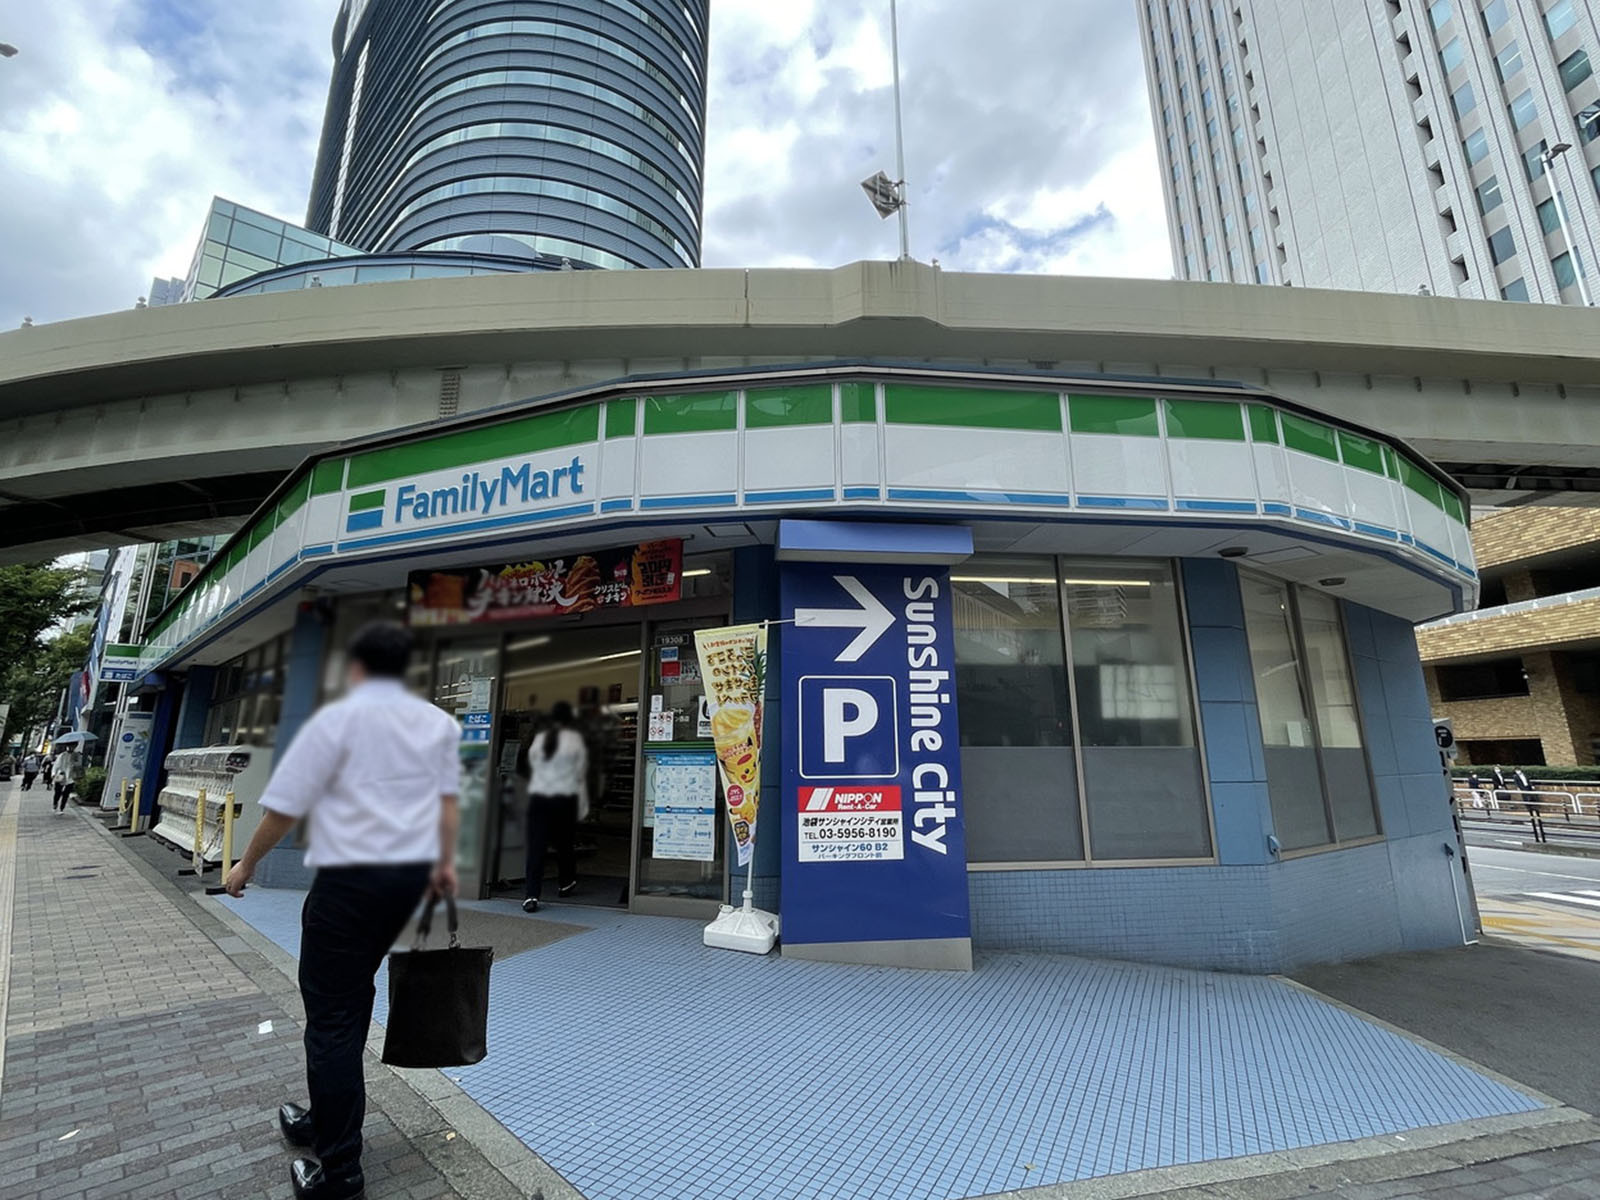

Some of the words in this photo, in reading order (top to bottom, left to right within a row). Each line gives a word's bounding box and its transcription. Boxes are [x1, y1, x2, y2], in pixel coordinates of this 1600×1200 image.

[395, 455, 584, 523] FamilyMart
[903, 576, 950, 752] Sunshine
[823, 688, 878, 762] P
[834, 793, 882, 804] NIPPON
[911, 763, 956, 855] City
[812, 844, 873, 853] サンシャイン60
[819, 827, 897, 839] 03-5956-8190
